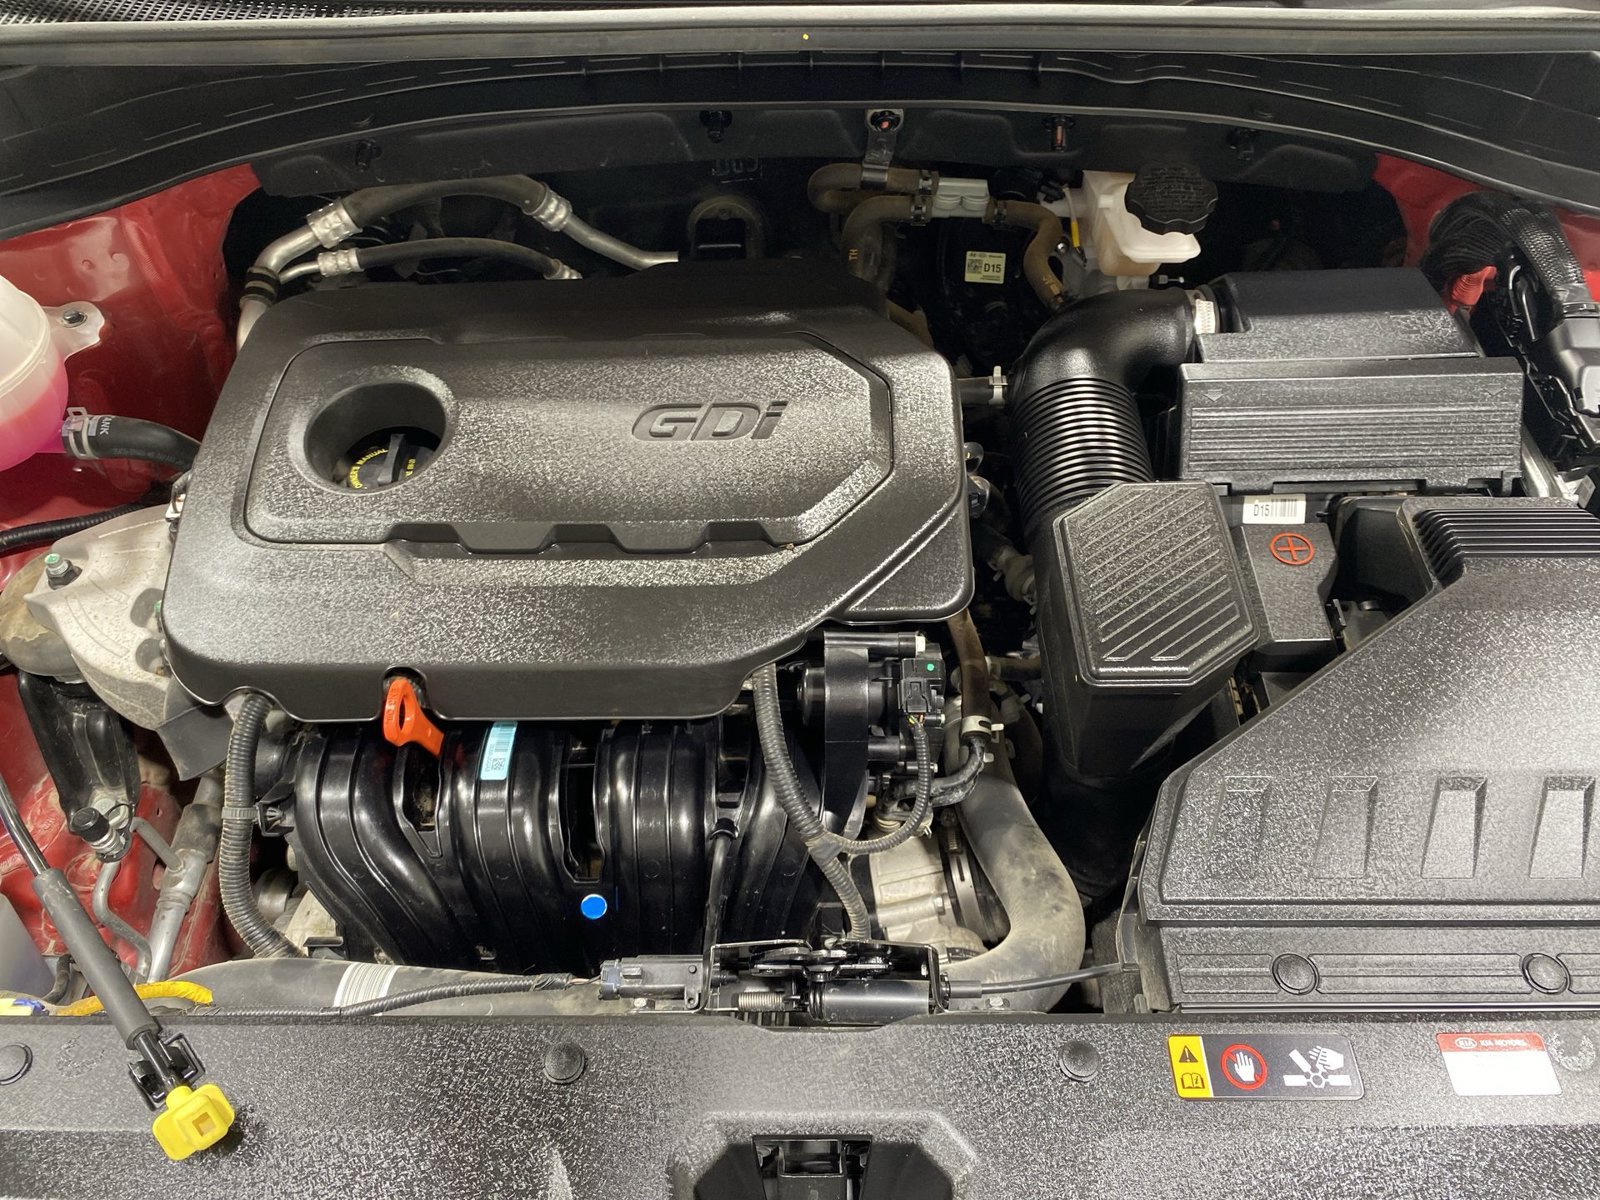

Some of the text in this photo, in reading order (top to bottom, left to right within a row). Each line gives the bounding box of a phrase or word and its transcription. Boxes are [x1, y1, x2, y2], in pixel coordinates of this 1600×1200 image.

[983, 263, 1002, 273] D15
[631, 400, 789, 441] GDi
[356, 448, 389, 465] MANUAL
[1253, 504, 1270, 517] D15
